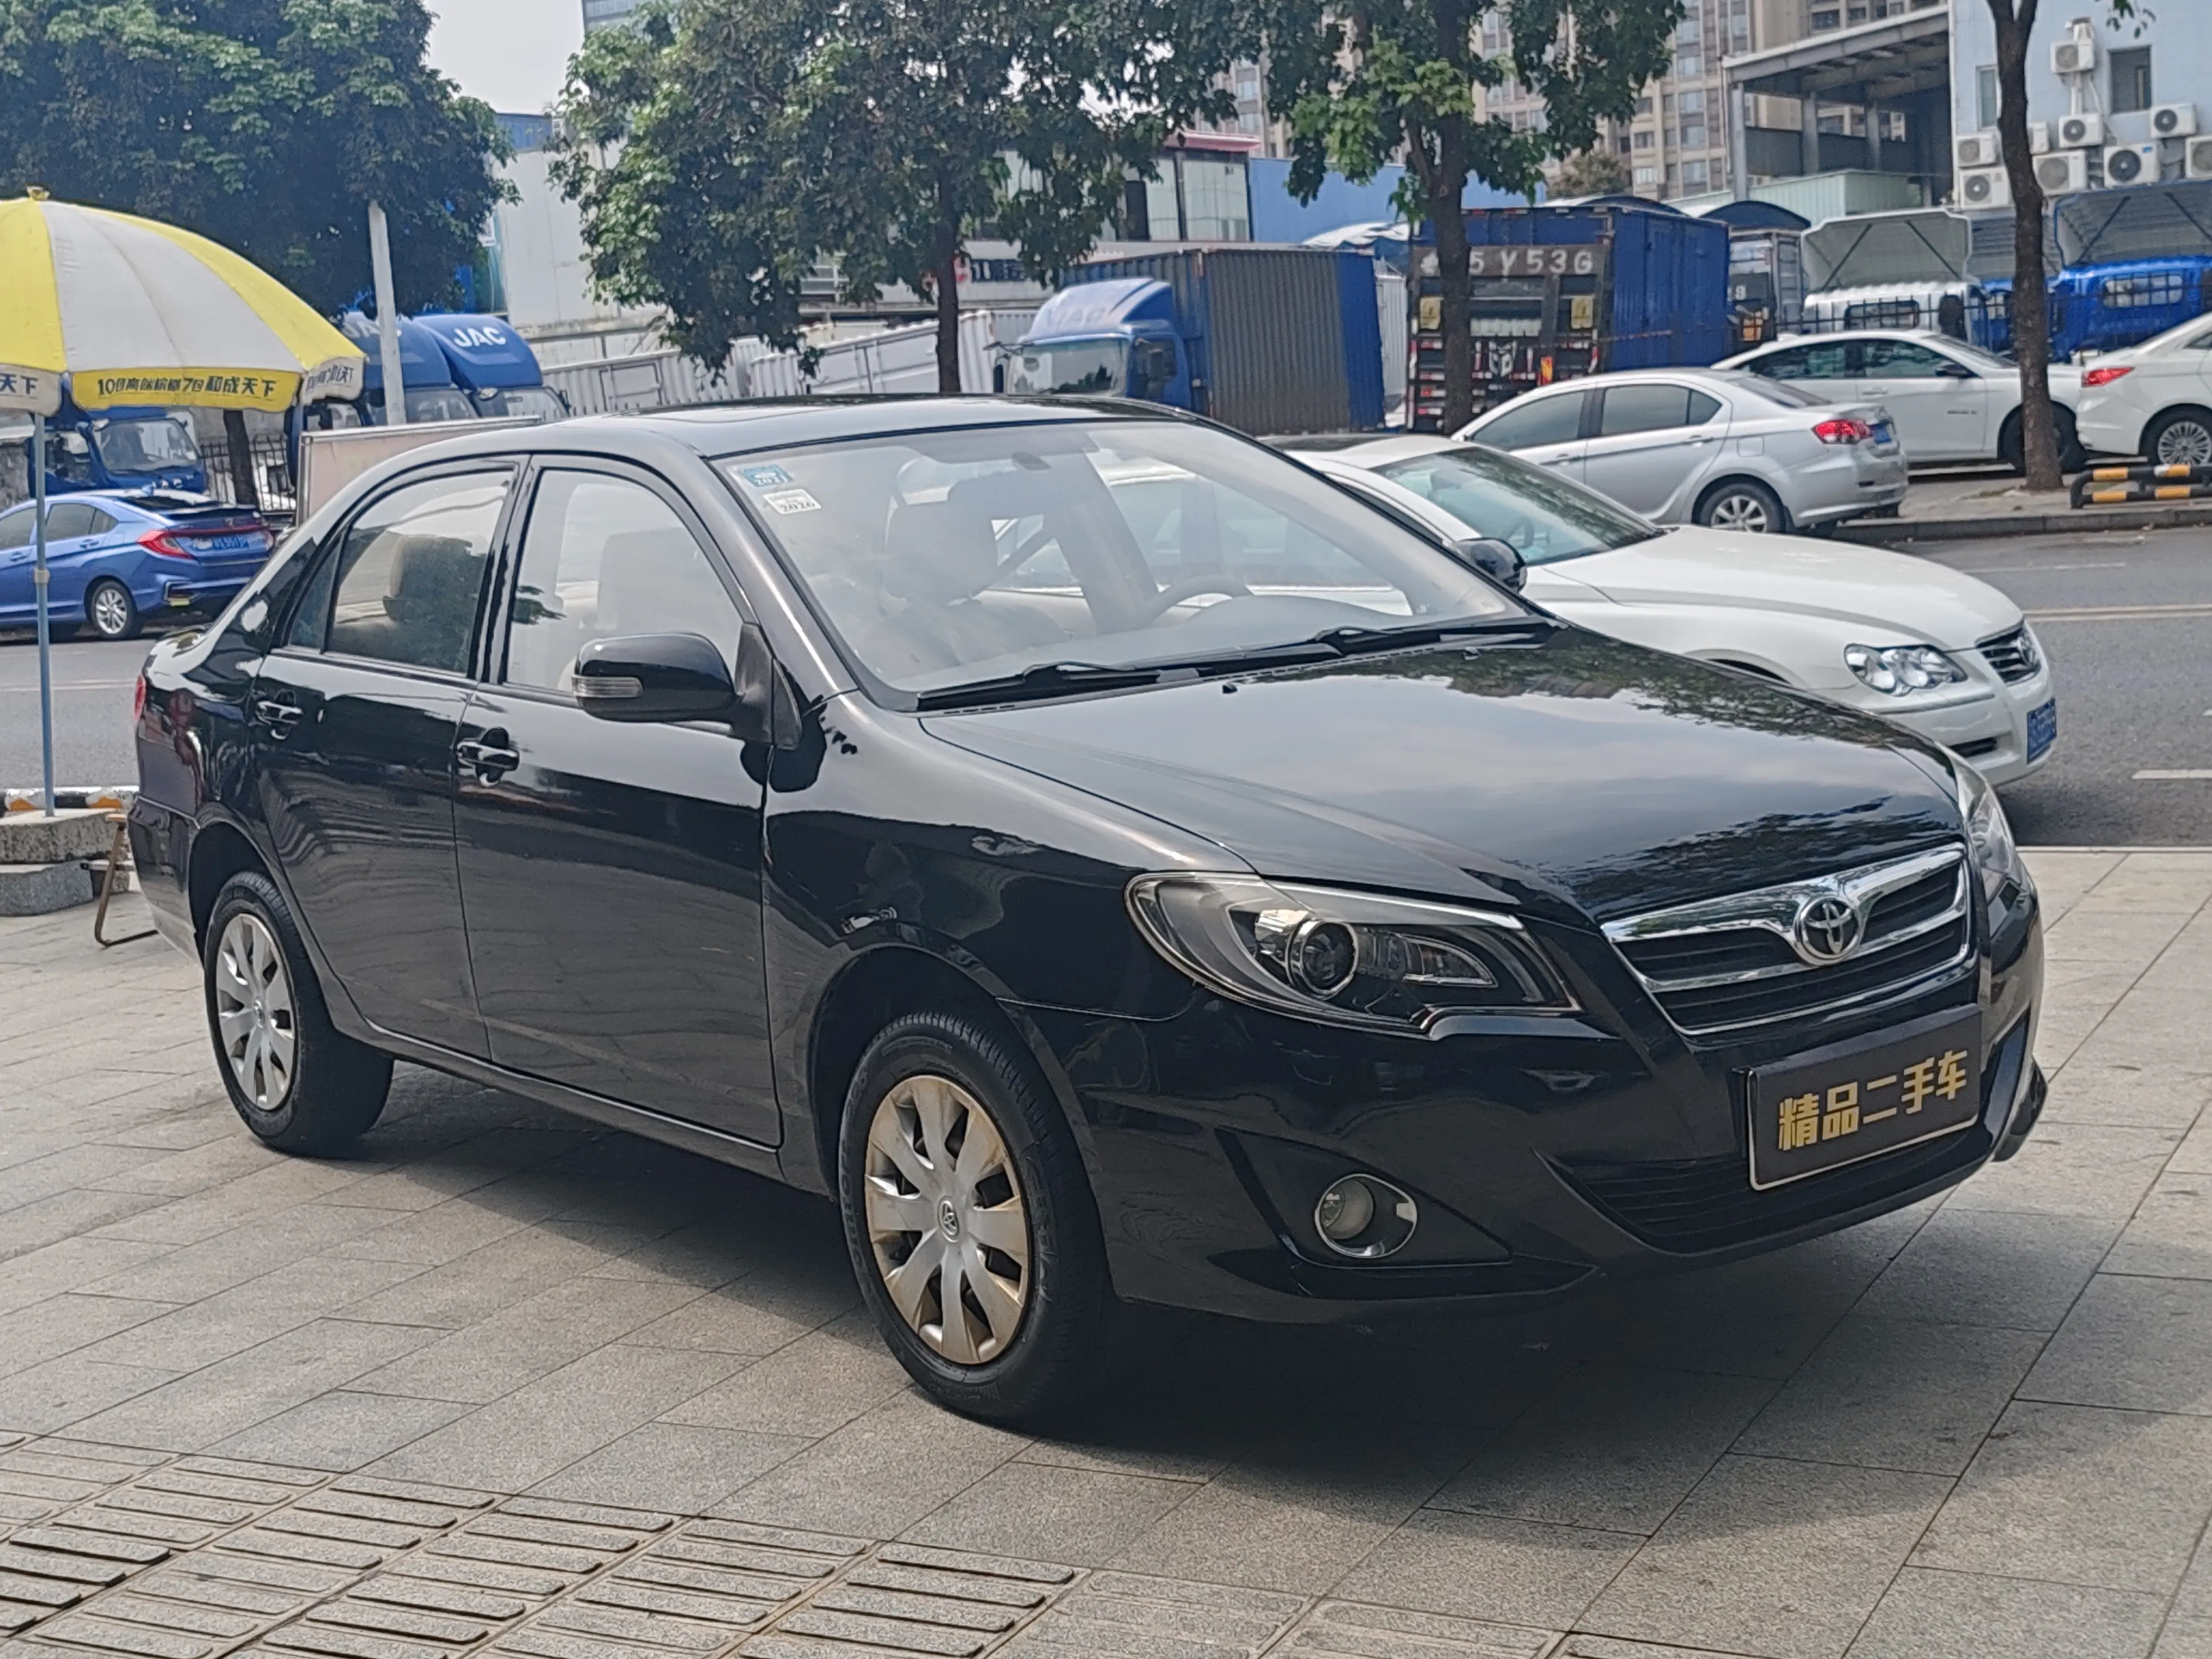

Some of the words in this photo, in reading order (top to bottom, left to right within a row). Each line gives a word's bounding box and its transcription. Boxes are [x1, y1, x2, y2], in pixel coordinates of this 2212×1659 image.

[453, 327, 507, 347] JAC
[1778, 1050, 1968, 1151] 精品二手车
